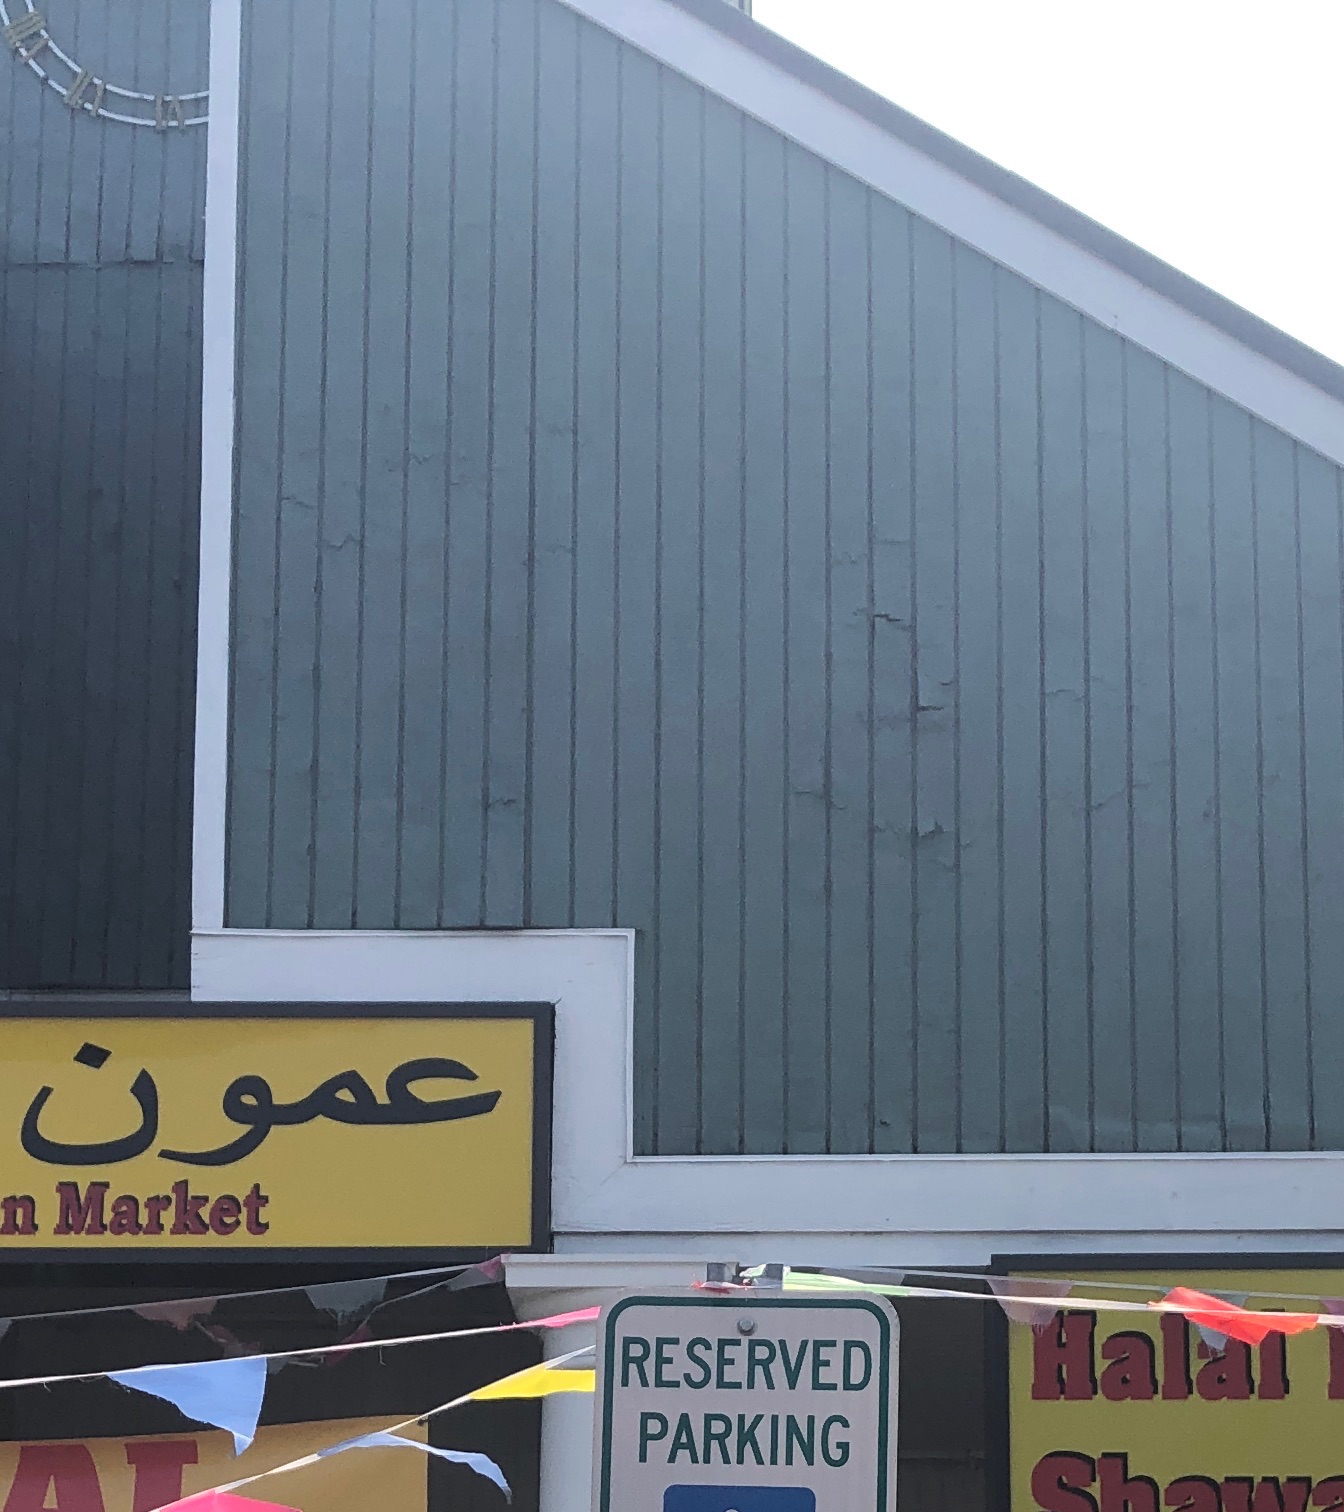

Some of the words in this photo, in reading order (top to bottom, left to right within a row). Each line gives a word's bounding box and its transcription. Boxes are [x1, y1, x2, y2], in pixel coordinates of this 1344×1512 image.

[20, 1042, 503, 1167] عمون
[55, 1180, 270, 1237] Market
[620, 1336, 872, 1391] RESERVED
[1031, 1308, 1290, 1401] Halal
[638, 1411, 850, 1467] PARKING
